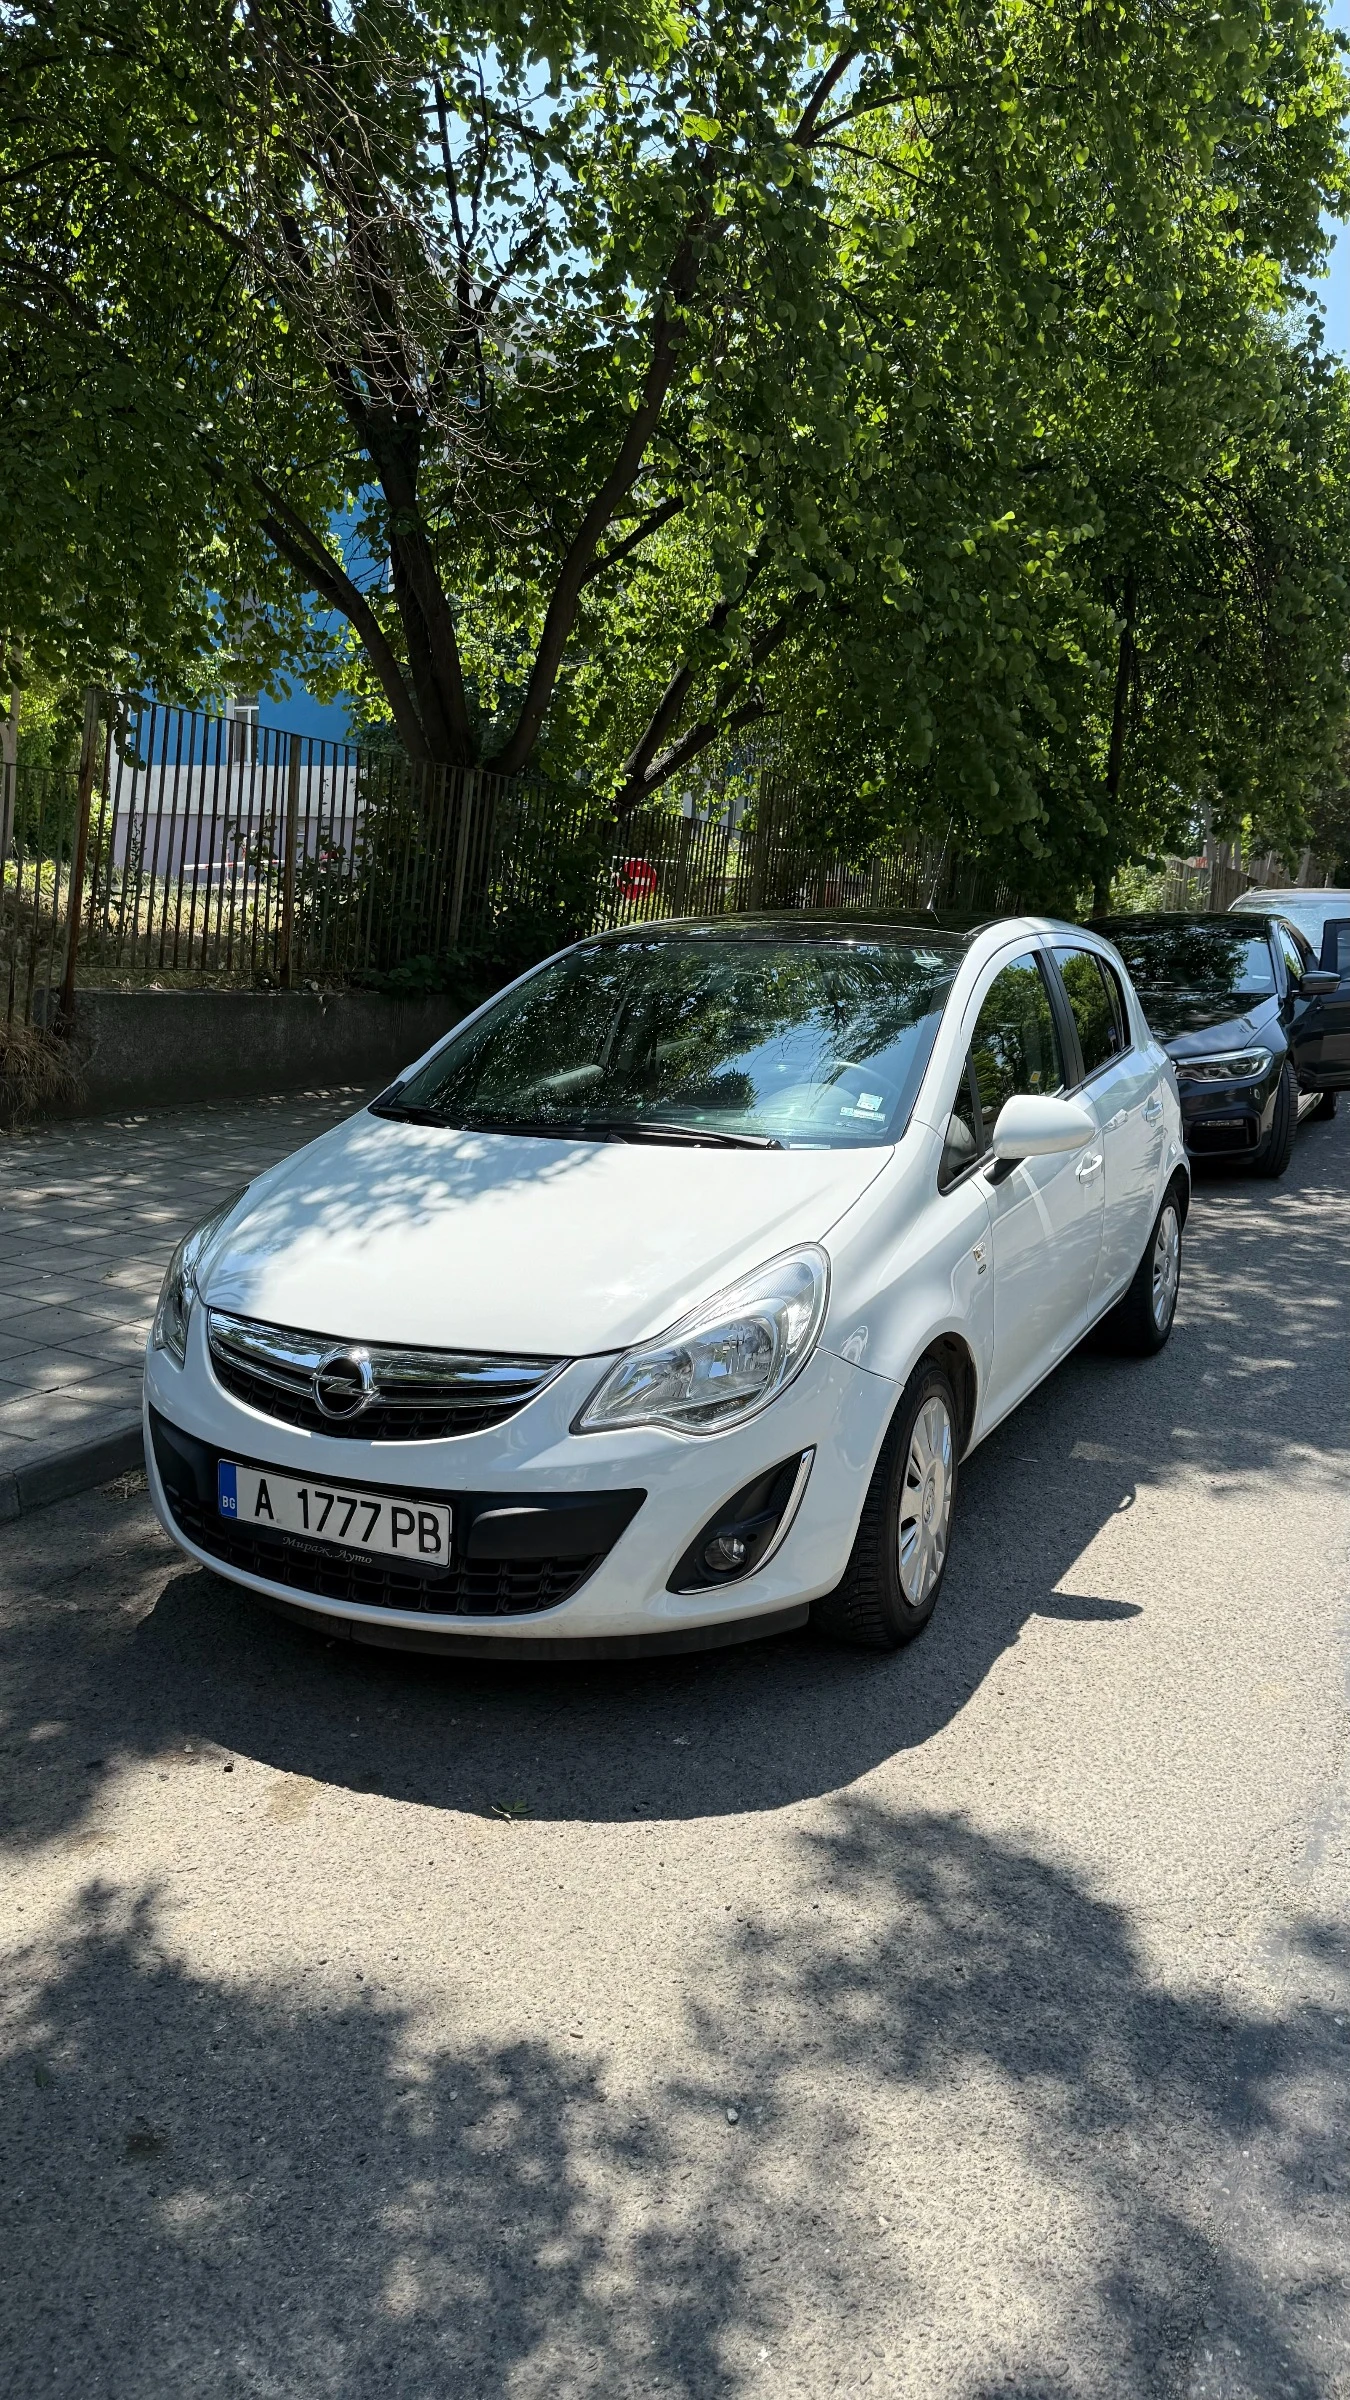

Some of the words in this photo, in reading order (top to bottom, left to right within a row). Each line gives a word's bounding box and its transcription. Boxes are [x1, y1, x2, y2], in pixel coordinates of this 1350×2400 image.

[222, 1495, 236, 1510] BG
[254, 1478, 275, 1520] A
[297, 1488, 382, 1543] 1777
[391, 1506, 442, 1554] PB
[282, 1536, 333, 1558] Мираж
[334, 1549, 373, 1564] Ауто
